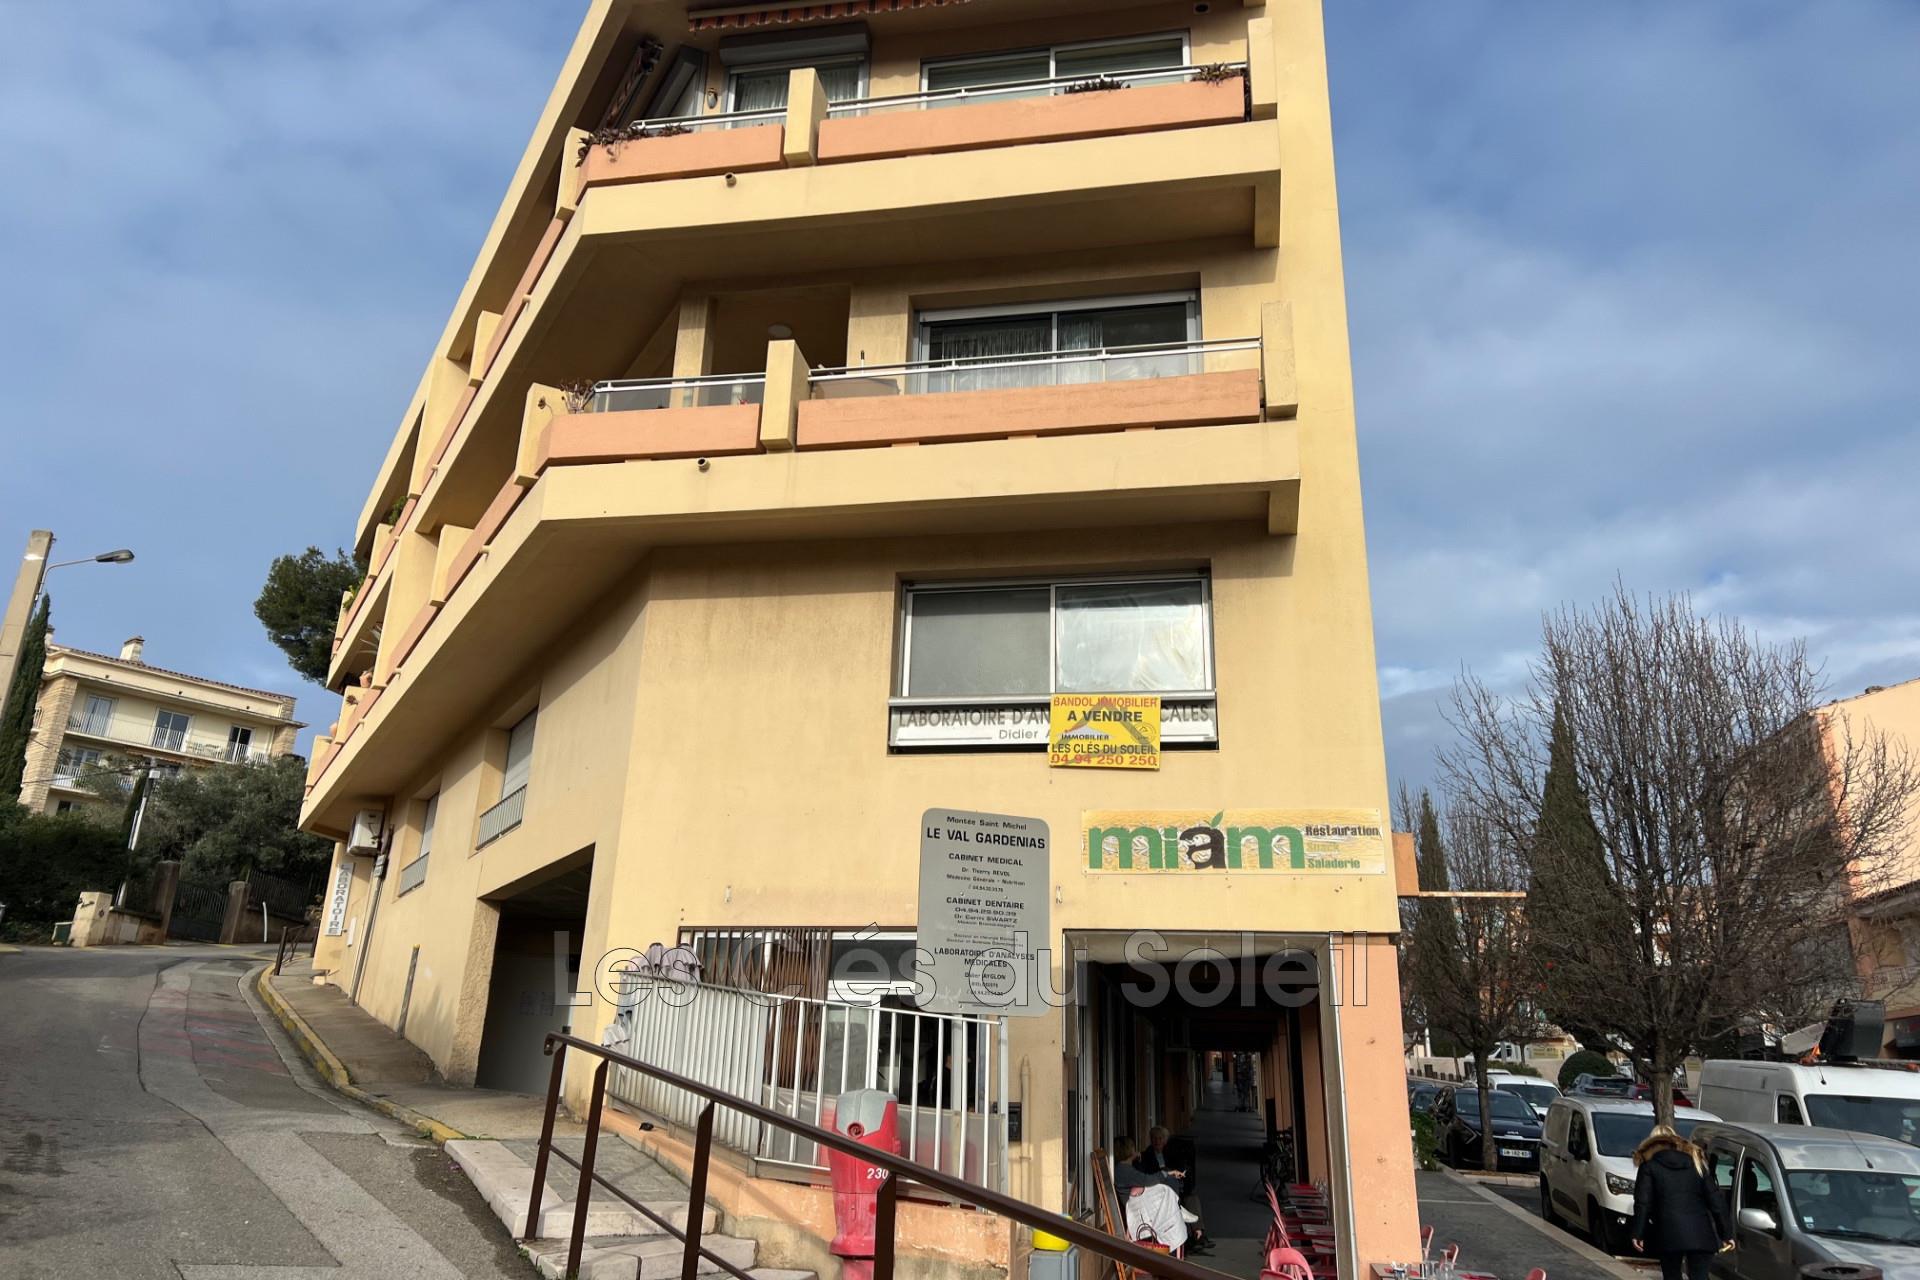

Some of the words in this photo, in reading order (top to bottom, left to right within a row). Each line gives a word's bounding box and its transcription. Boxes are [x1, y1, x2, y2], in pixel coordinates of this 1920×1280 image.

[1053, 696, 1094, 707] BANDOL
[1096, 696, 1158, 708] IMMOBILIER
[899, 709, 1005, 727] LABORATOIRE
[1067, 710, 1077, 722] A
[1082, 711, 1143, 722] VENDRE
[999, 729, 1038, 740] Didier
[1051, 743, 1071, 753] LES
[1073, 741, 1100, 753] CLÉS
[1103, 744, 1117, 754] DU
[1120, 744, 1156, 755] SOLEIL
[1050, 753, 1069, 764] 04
[1073, 754, 1092, 764] 94
[1096, 755, 1124, 766] 250
[1129, 756, 1157, 766] 250
[979, 819, 999, 828] Saint
[1002, 821, 1027, 831] Michel
[927, 827, 941, 839] LE
[947, 829, 970, 842] VAL
[975, 832, 1045, 849] GARDENIAS
[1088, 826, 1305, 870] miam
[948, 853, 984, 863] CABINET
[987, 856, 1024, 867] MEDICAL
[1307, 858, 1360, 869] Saladerie
[946, 897, 981, 906] CABINET
[985, 900, 1025, 910] DENTAIRE
[934, 948, 985, 958] LABORATOIRE
[867, 1168, 889, 1179] 230
